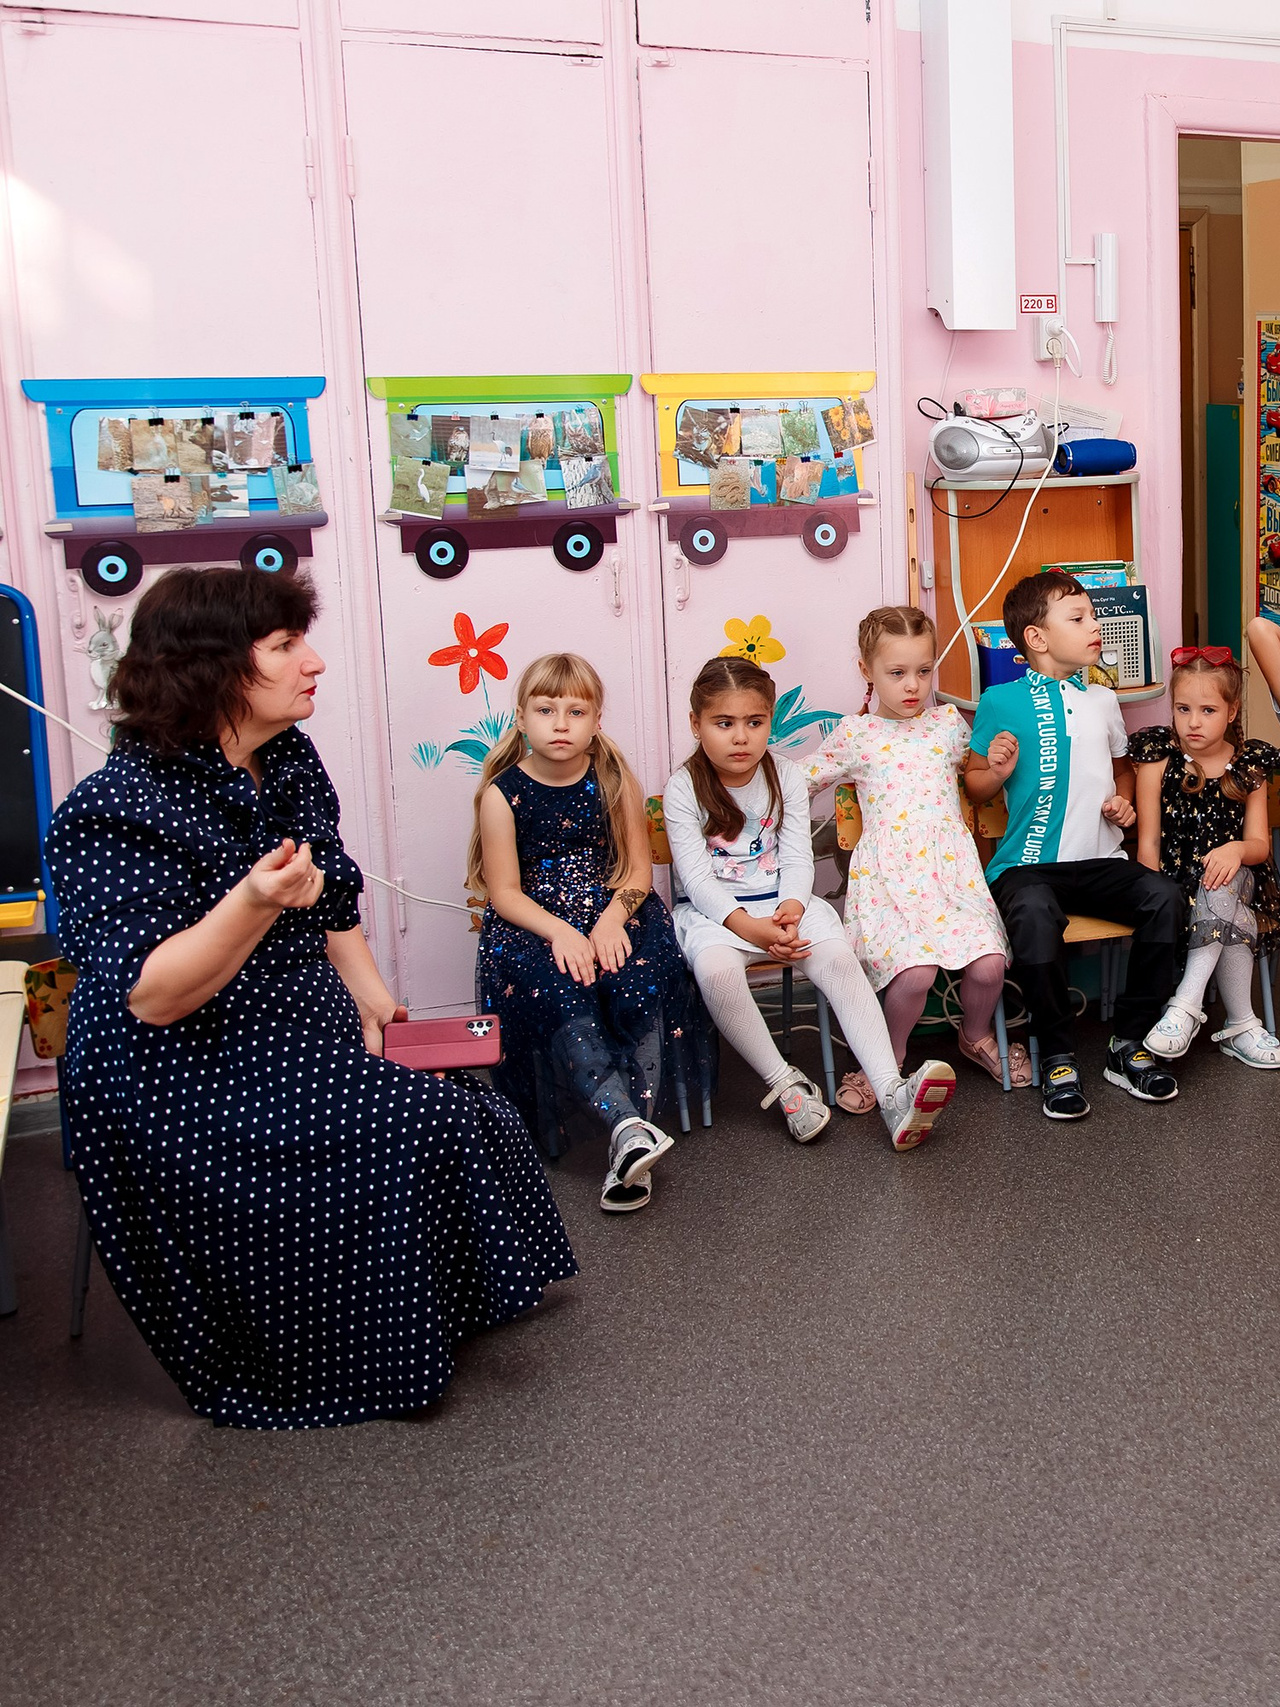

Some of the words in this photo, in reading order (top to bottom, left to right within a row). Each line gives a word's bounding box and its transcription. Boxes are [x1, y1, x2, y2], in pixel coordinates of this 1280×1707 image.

[1023, 299, 1043, 309] 220
[1029, 685, 1053, 711] STAY
[1036, 712, 1058, 773] PLUGGED
[1039, 775, 1057, 791] IN
[1032, 794, 1054, 824] STAY
[1020, 825, 1047, 866] PLUGG
